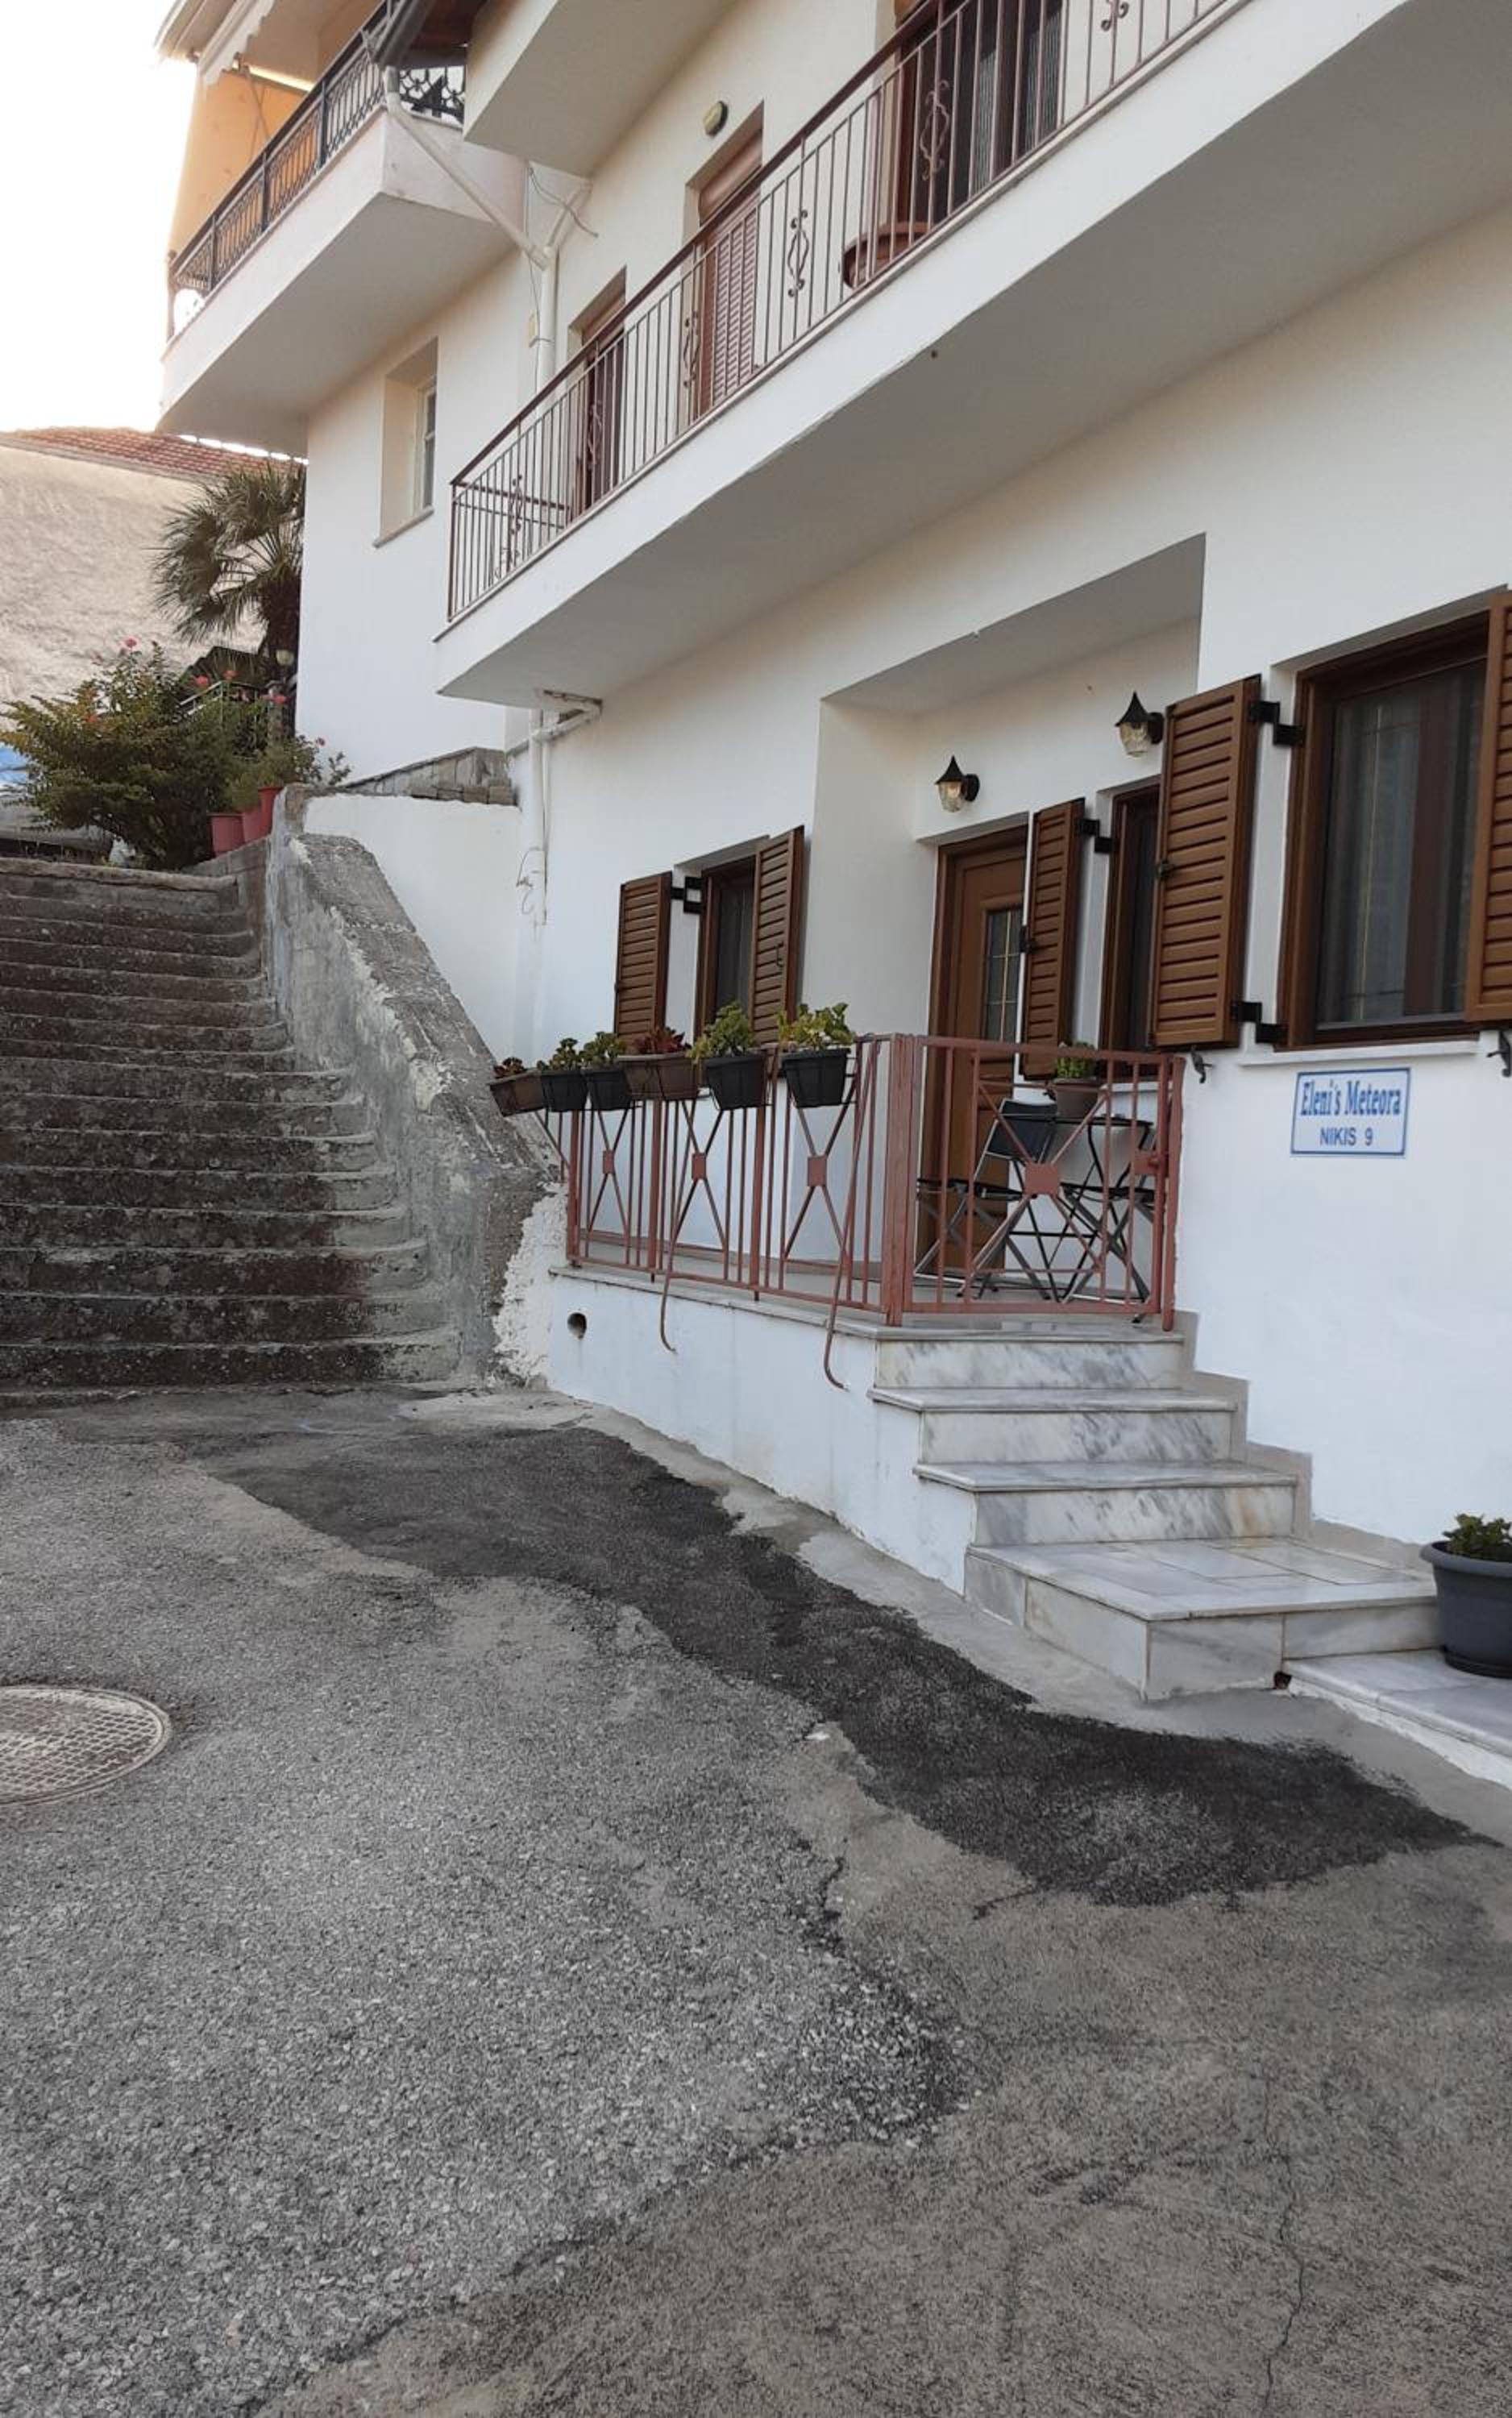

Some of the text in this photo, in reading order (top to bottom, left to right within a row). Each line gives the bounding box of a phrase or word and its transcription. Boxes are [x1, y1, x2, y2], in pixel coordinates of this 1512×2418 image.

[1301, 1079, 1401, 1116] Eleni's Meteora
[1320, 1127, 1373, 1146] NIKIS 9
